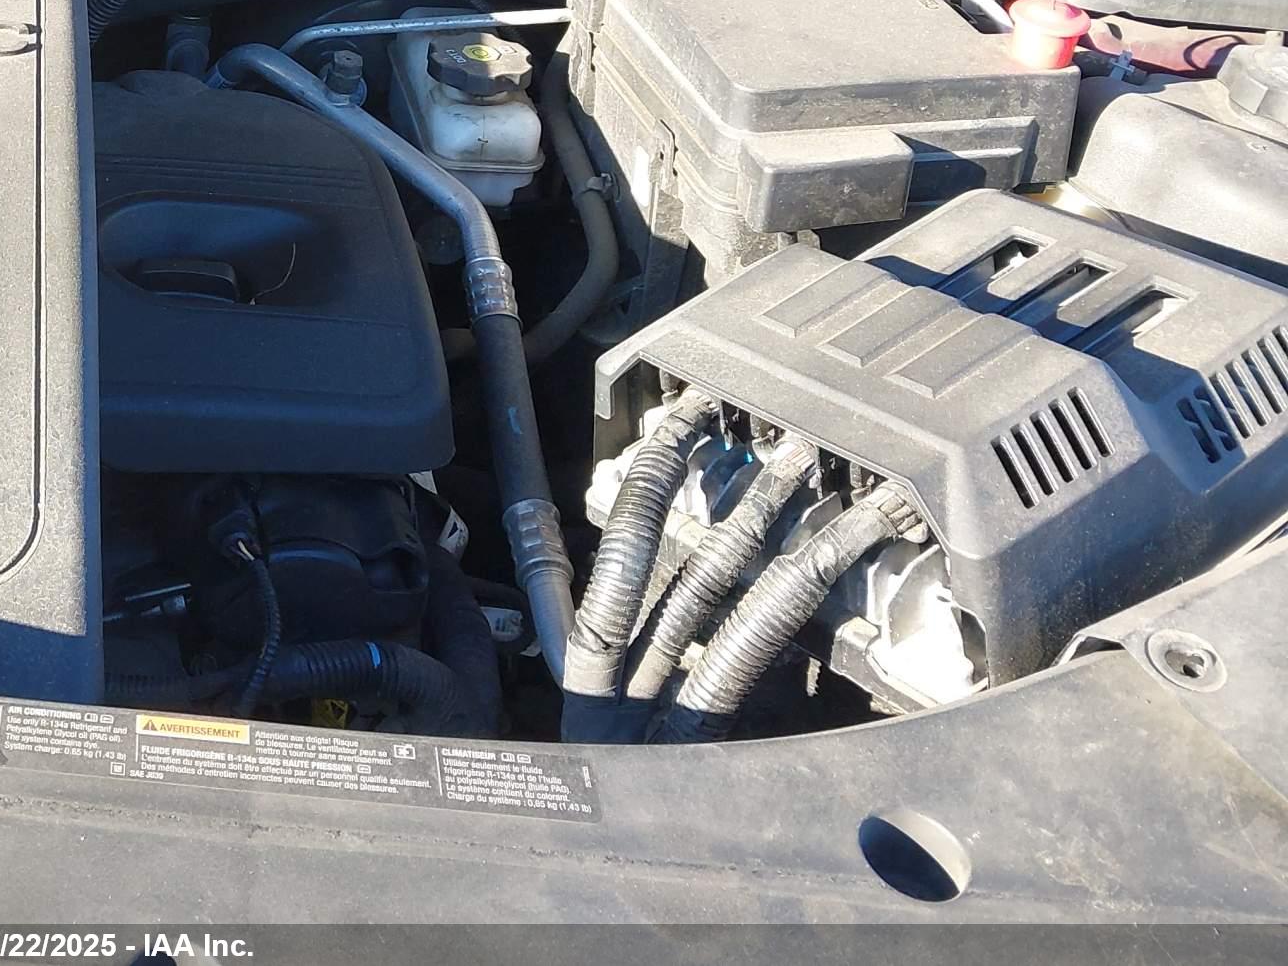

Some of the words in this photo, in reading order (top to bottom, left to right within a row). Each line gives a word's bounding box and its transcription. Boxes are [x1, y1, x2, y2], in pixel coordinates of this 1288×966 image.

[8, 706, 22, 714] AIR
[24, 707, 81, 720] CONDITIONING
[7, 716, 21, 724] Use
[23, 718, 39, 726] only
[40, 719, 68, 728] R-134a
[71, 722, 111, 733] Refrigerant
[113, 726, 127, 734] and
[160, 723, 240, 738] AVERTISSEMENT
[6, 725, 52, 736] Polyalkylene
[55, 730, 76, 738] Glycol
[90, 733, 107, 741] (PAG
[6, 733, 19, 741] The
[22, 735, 48, 744] system
[50, 738, 81, 746] contains
[255, 731, 288, 741] Attention
[333, 738, 358, 747] Risque
[4, 741, 32, 751] System
[84, 749, 93, 758] kg
[256, 747, 280, 755] mettre
[289, 750, 316, 758] tourner
[442, 749, 496, 760] CLIMATISEUR
[141, 746, 170, 755] FLUIDE
[259, 757, 280, 765] SOUS
[283, 759, 309, 768] HAUTE
[312, 761, 352, 772] PRESSION
[183, 758, 192, 766] du
[443, 758, 469, 767] Utiliser
[471, 761, 510, 771] seulement
[522, 766, 542, 774] fluide
[130, 770, 144, 778] SAE
[141, 762, 155, 770] Des
[284, 777, 314, 786] peuvent
[487, 771, 515, 780] R-134a
[492, 788, 523, 797] contient
[448, 792, 474, 802] Charge
[547, 801, 557, 810] kg
